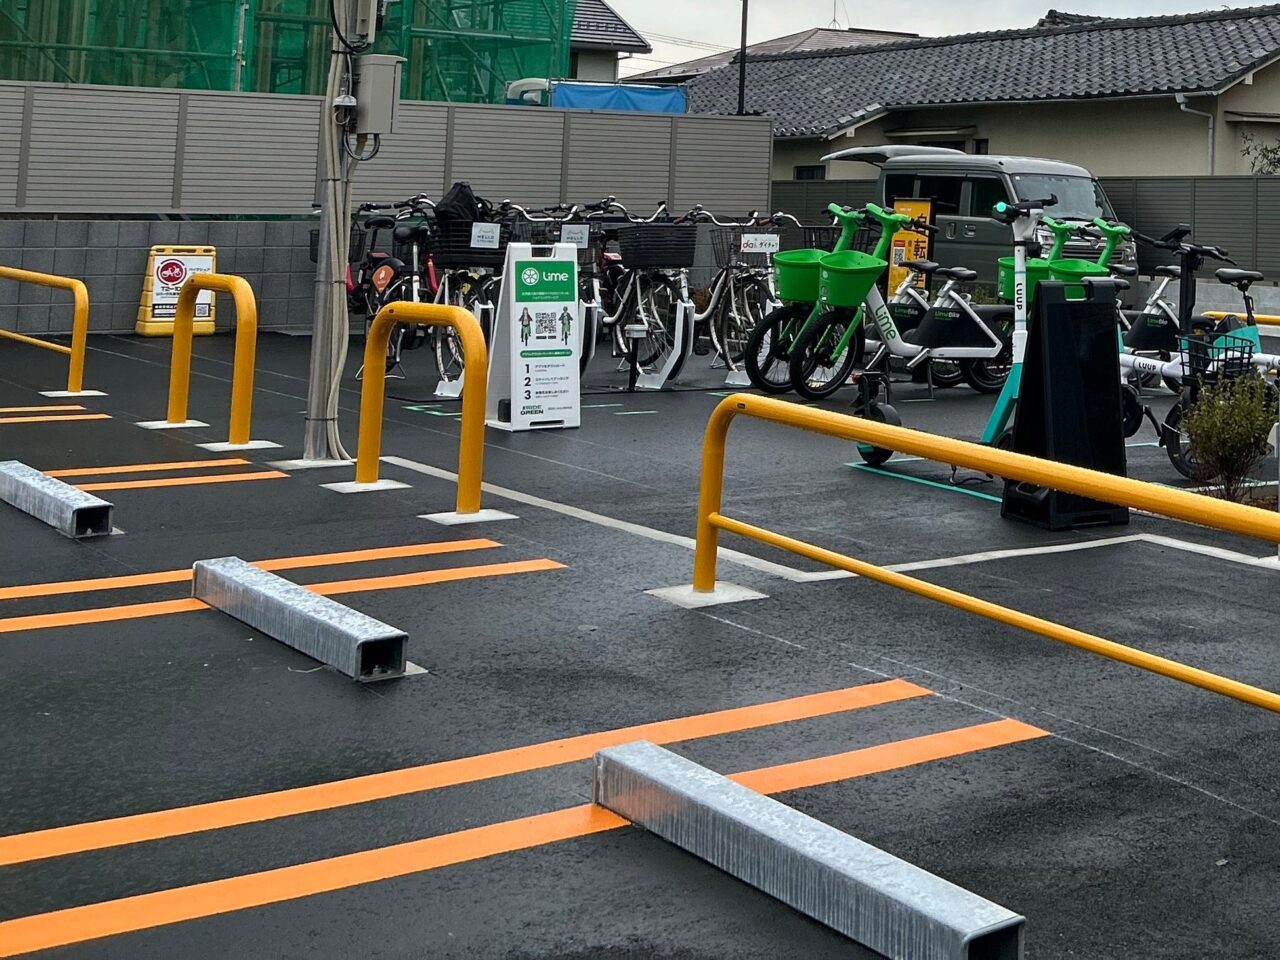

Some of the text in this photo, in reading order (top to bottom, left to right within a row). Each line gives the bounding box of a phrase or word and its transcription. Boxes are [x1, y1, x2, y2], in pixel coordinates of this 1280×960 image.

[542, 271, 569, 282] Lime
[934, 309, 960, 318] LimeBike
[874, 304, 897, 340] Lime
[525, 363, 530, 374] 1
[1138, 361, 1157, 371] LUUP
[524, 376, 532, 387] 2
[524, 389, 532, 400] 3
